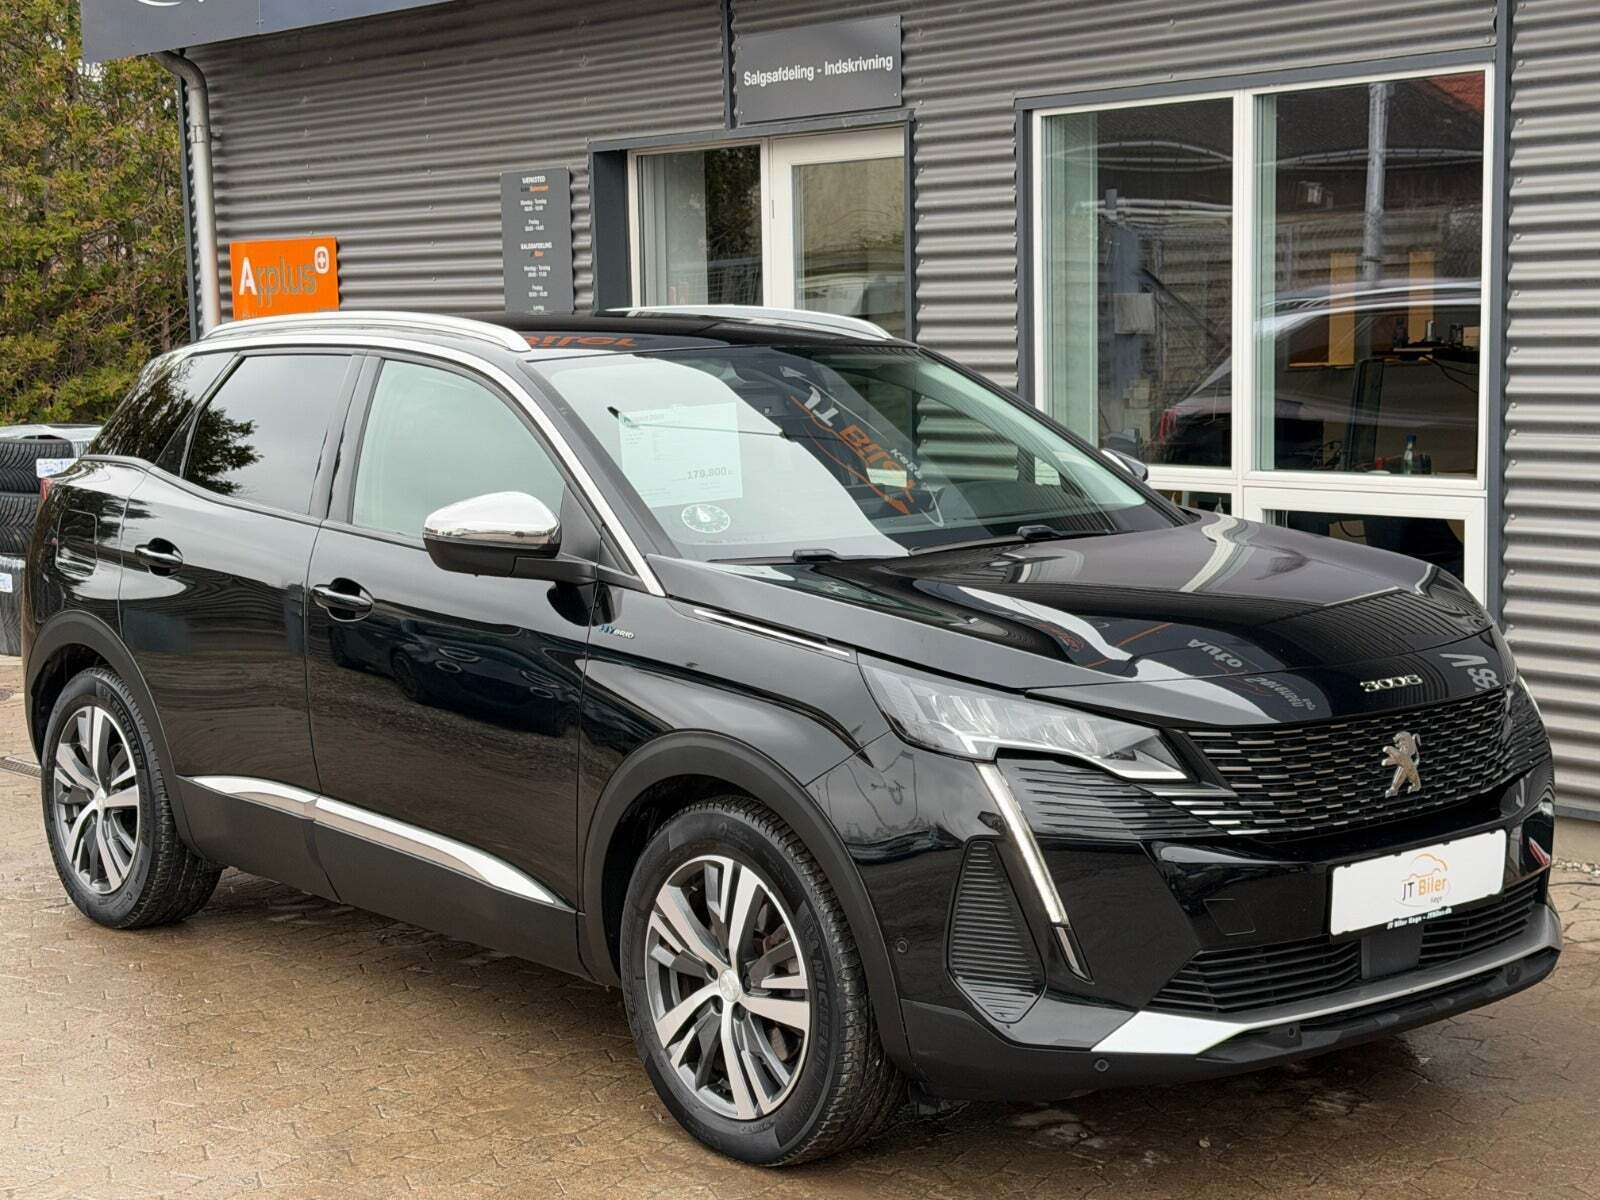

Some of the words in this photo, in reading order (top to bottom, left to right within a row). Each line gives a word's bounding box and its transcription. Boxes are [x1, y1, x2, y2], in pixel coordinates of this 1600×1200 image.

[743, 65, 814, 87] Salgsafdeling
[824, 54, 893, 76] Indskrivning
[1360, 674, 1424, 693] 3008
[1402, 882, 1415, 901] JT
[1418, 877, 1448, 896] Biler
